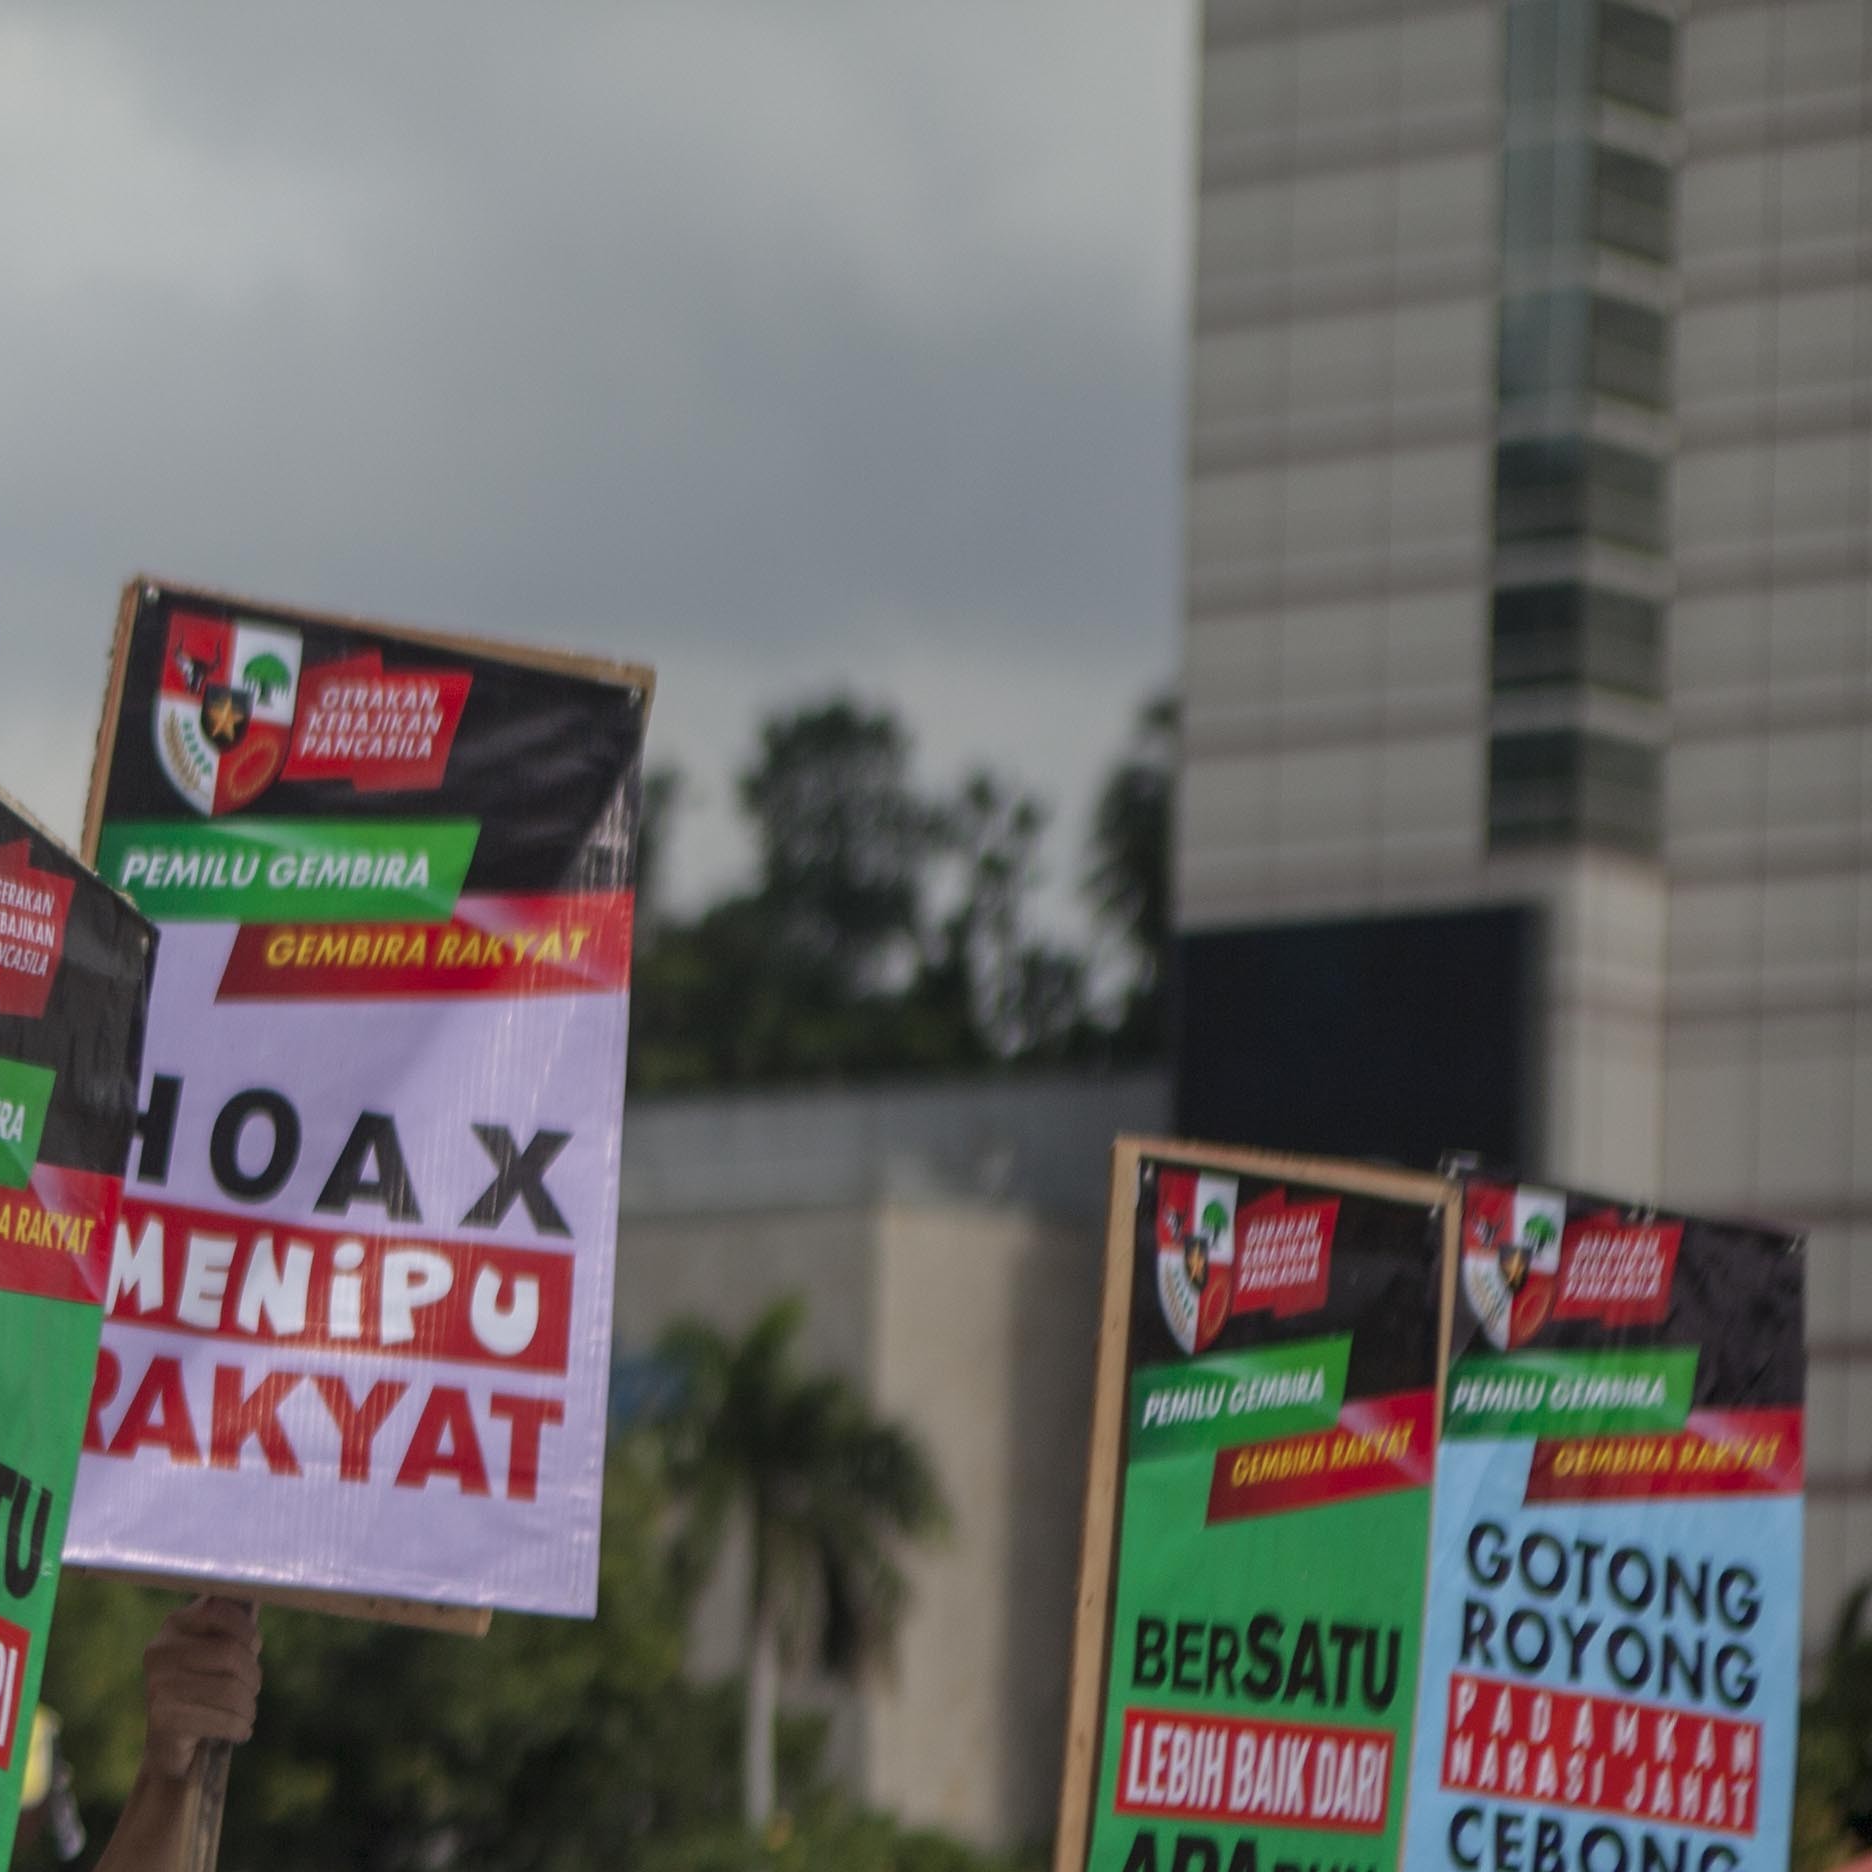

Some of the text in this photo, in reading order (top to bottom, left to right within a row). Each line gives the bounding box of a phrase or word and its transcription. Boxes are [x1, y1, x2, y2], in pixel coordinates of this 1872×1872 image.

[120, 853, 430, 889] PEMILU GEMBIRA
[266, 929, 591, 968] GEMBIRA RAKYAT
[15, 1207, 94, 1256] RAKYAT
[82, 1347, 564, 1503] RAKYAT
[1143, 1367, 1325, 1428] PEMILU GEMBIRA
[1452, 1379, 1545, 1413] PEMILU
[1232, 1419, 1414, 1487] GEMBIRA RAKYAT
[1467, 1521, 1760, 1635] GOTONG
[1132, 1611, 1403, 1711] BERSATU
[1460, 1598, 1758, 1708] ROYONG
[1126, 1718, 1388, 1824] LEBIH BAIK DARI
